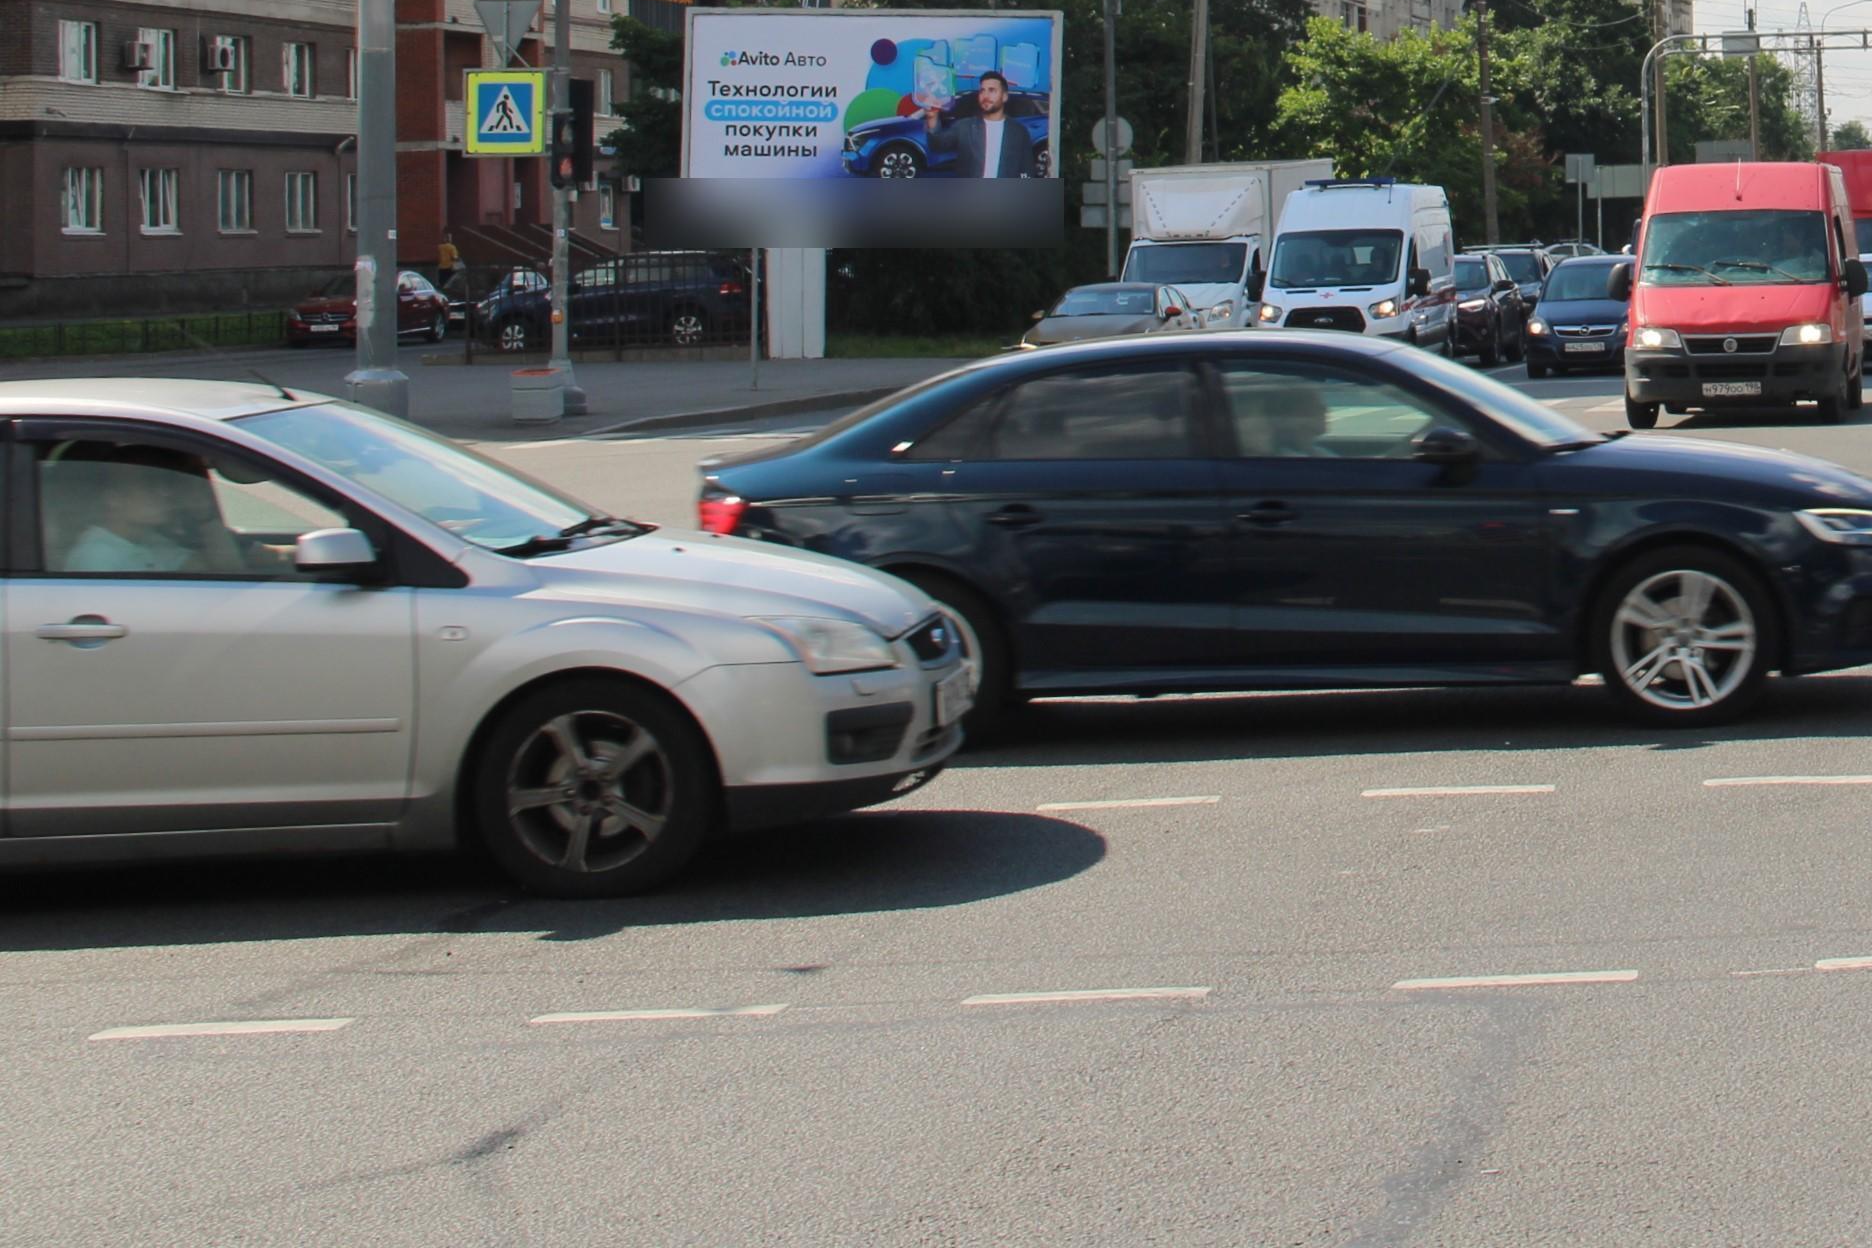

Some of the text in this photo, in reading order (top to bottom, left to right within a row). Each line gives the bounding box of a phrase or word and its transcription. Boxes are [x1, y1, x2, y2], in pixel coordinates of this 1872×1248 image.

[738, 51, 827, 67] Avito Авто
[707, 80, 837, 98] Технологии
[711, 101, 832, 118] спокойной
[725, 124, 818, 142] покупки
[724, 145, 817, 157] машины
